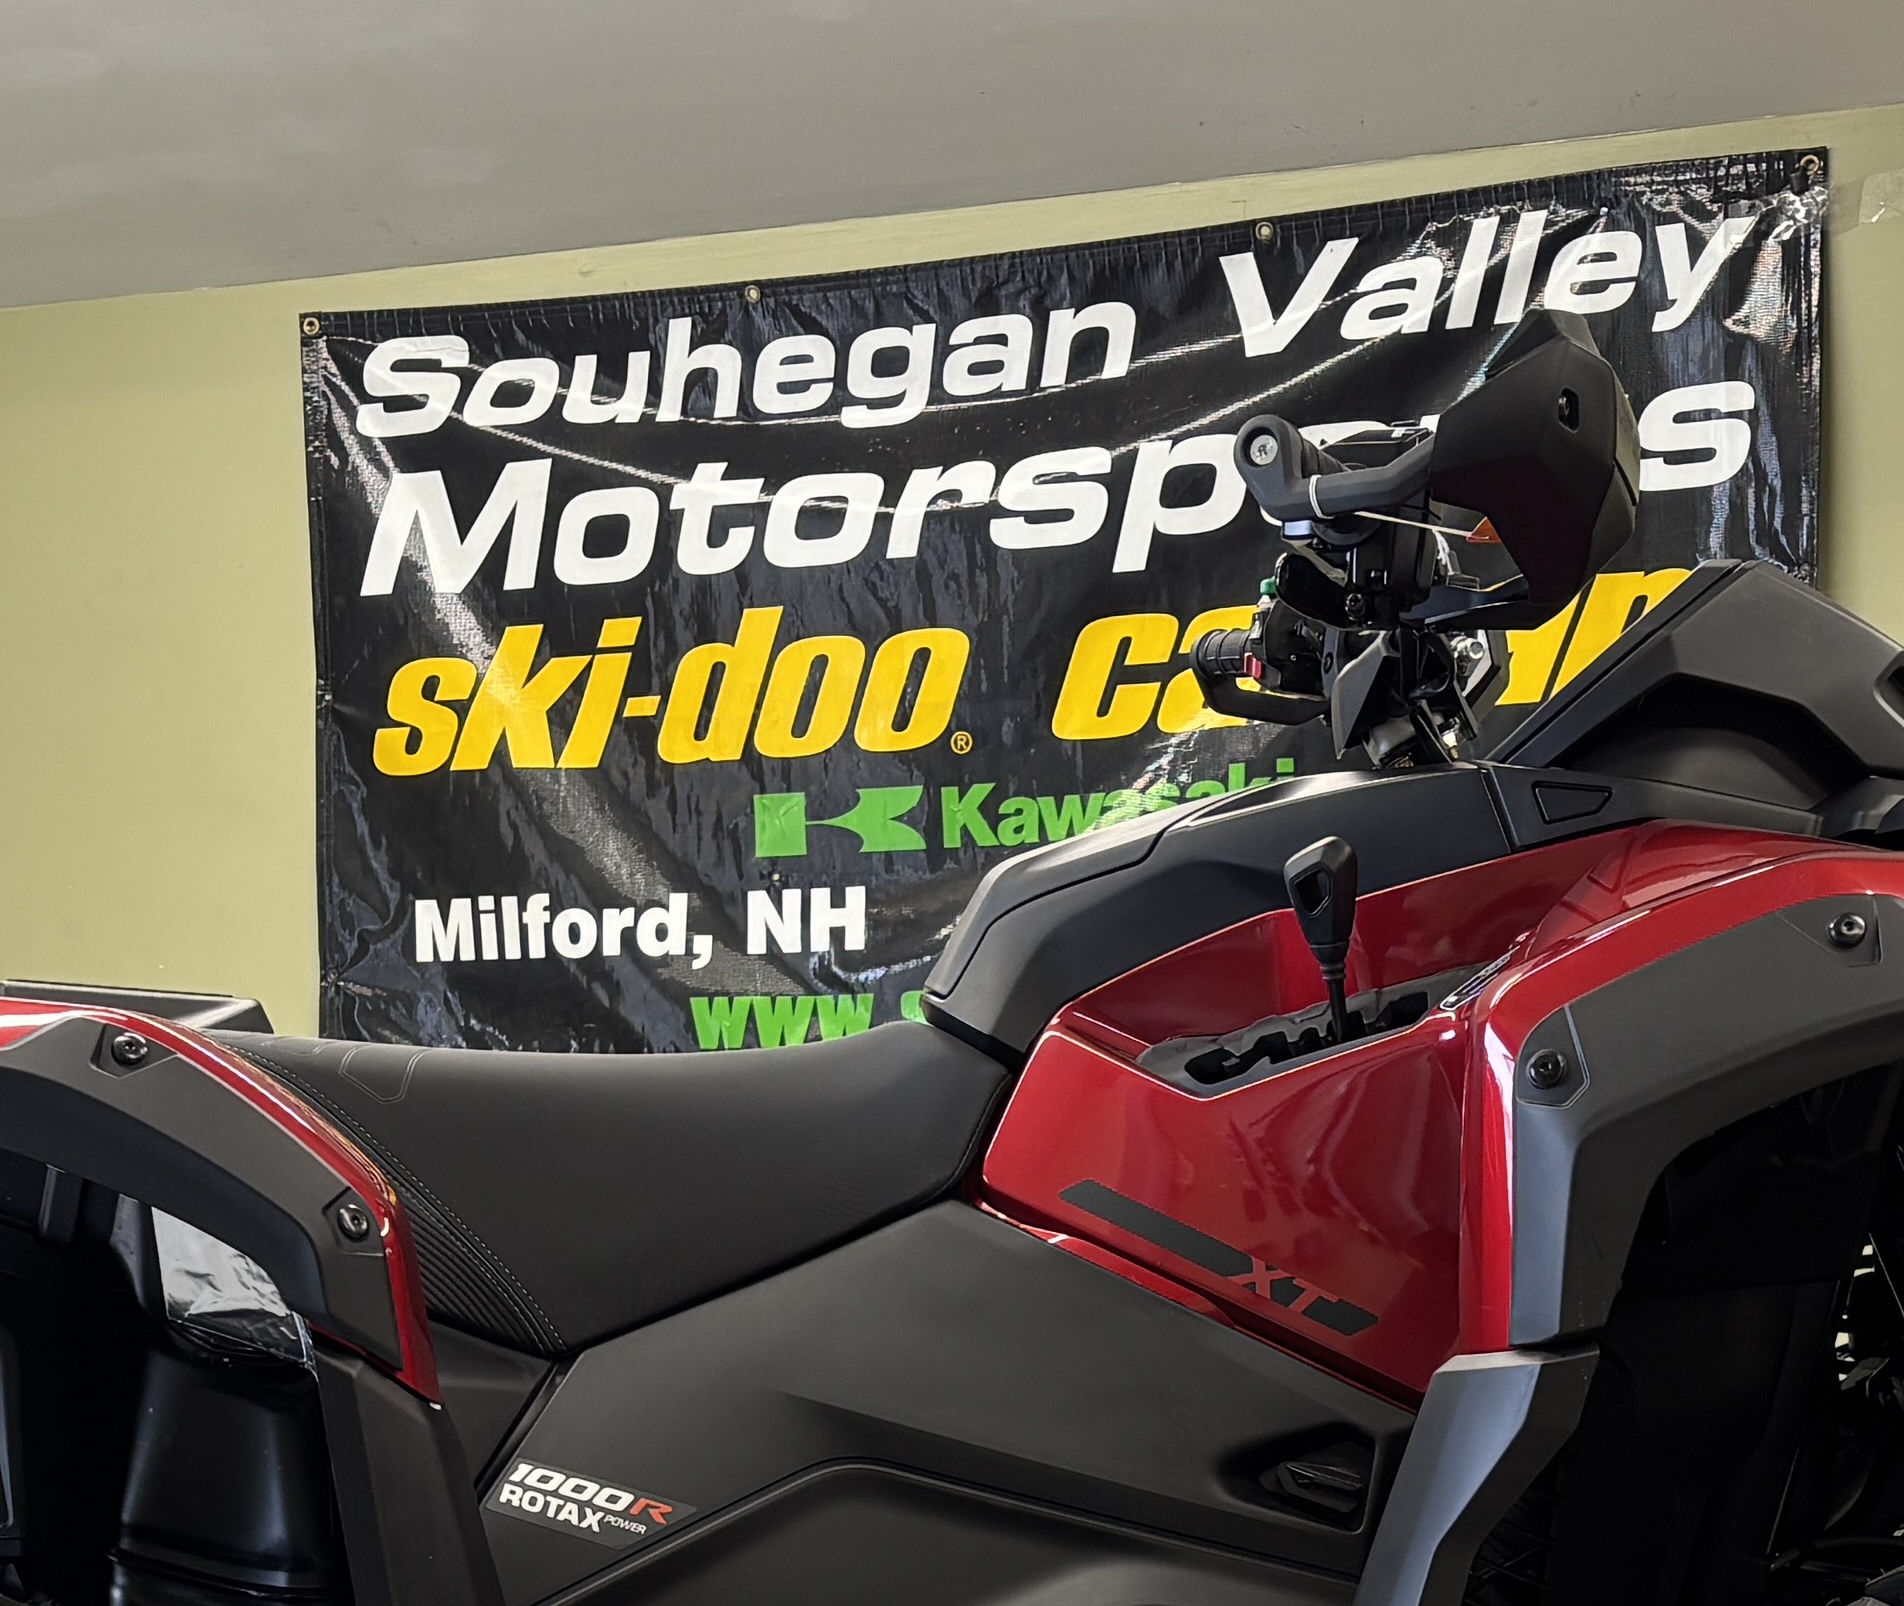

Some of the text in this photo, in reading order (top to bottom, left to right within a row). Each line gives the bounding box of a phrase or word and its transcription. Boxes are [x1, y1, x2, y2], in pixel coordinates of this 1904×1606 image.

[355, 210, 1756, 438] Souhegan Valley
[359, 381, 1756, 597] Motorsps
[372, 606, 972, 776] ski-doo
[414, 886, 867, 971] Milford, NH
[1222, 1253, 1341, 1316] XT
[499, 1483, 648, 1536] ROTAX POWER
[508, 1462, 674, 1525] 1000R
